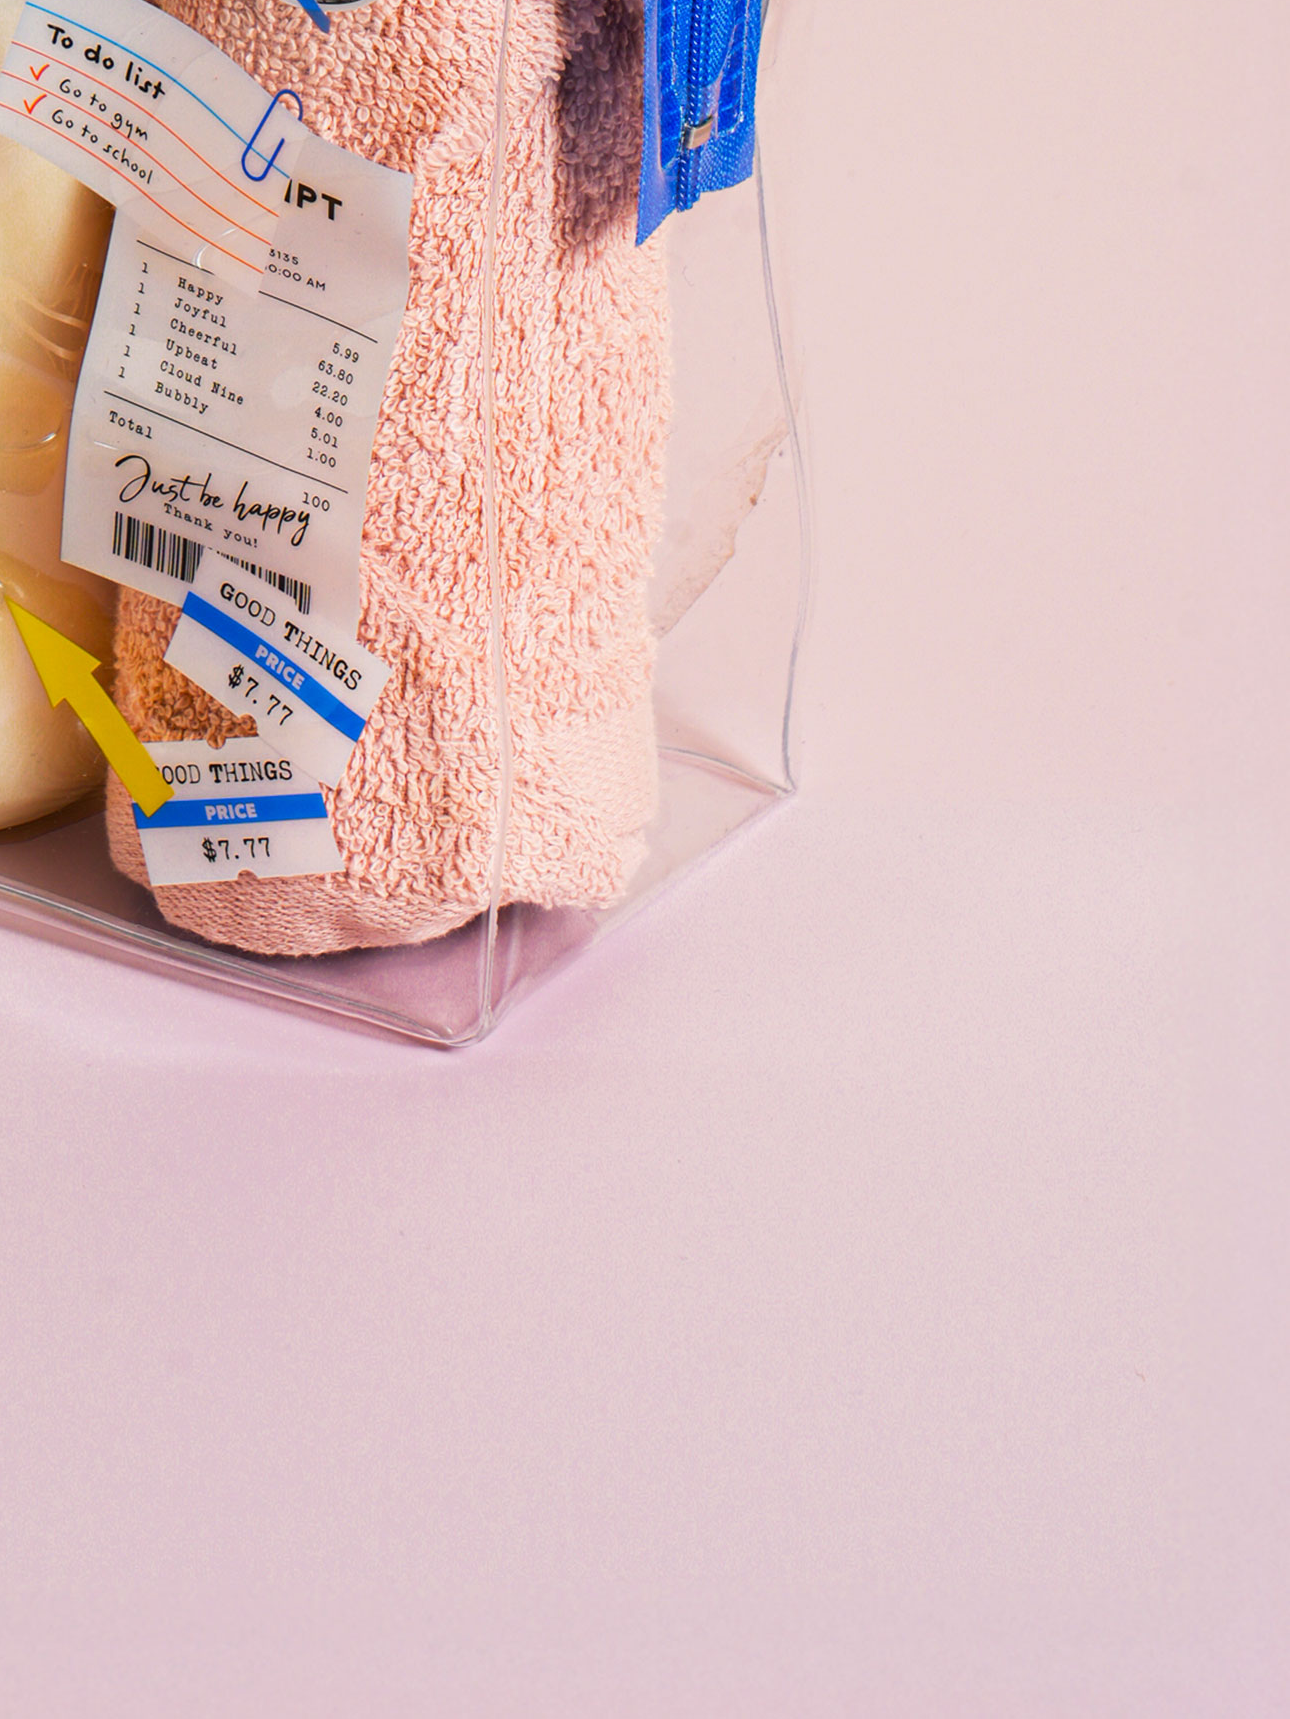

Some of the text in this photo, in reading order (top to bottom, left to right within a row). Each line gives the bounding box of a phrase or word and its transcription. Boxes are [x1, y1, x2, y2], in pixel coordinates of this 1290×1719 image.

[47, 23, 166, 99] To do list
[52, 109, 153, 184] Go to school
[59, 78, 148, 141] Go to gym
[265, 263, 326, 291] 0:00 AM
[174, 297, 227, 328] Joyful
[318, 360, 354, 385] 63.80
[177, 277, 224, 305] Happy
[332, 342, 360, 364] 5.99
[165, 339, 218, 370] Upbeat
[314, 406, 344, 428] 4.00
[169, 318, 238, 356] Cheerful
[312, 381, 349, 407] 22.20
[154, 381, 209, 415] Bubbly
[306, 447, 337, 468] 1.00
[159, 360, 202, 388] Cloud
[211, 381, 244, 405] Nine
[310, 427, 339, 449] 5.01
[109, 410, 331, 512] Total 100
[114, 453, 311, 547] Just be happy
[163, 502, 258, 548] Thank you!
[220, 581, 363, 691] GOOD THINGS
[255, 644, 306, 691] PRICE
[227, 664, 295, 727] $7.77
[155, 759, 294, 785] OOD THINGS
[205, 801, 258, 821] PRICE
[201, 837, 272, 864] $7.77
